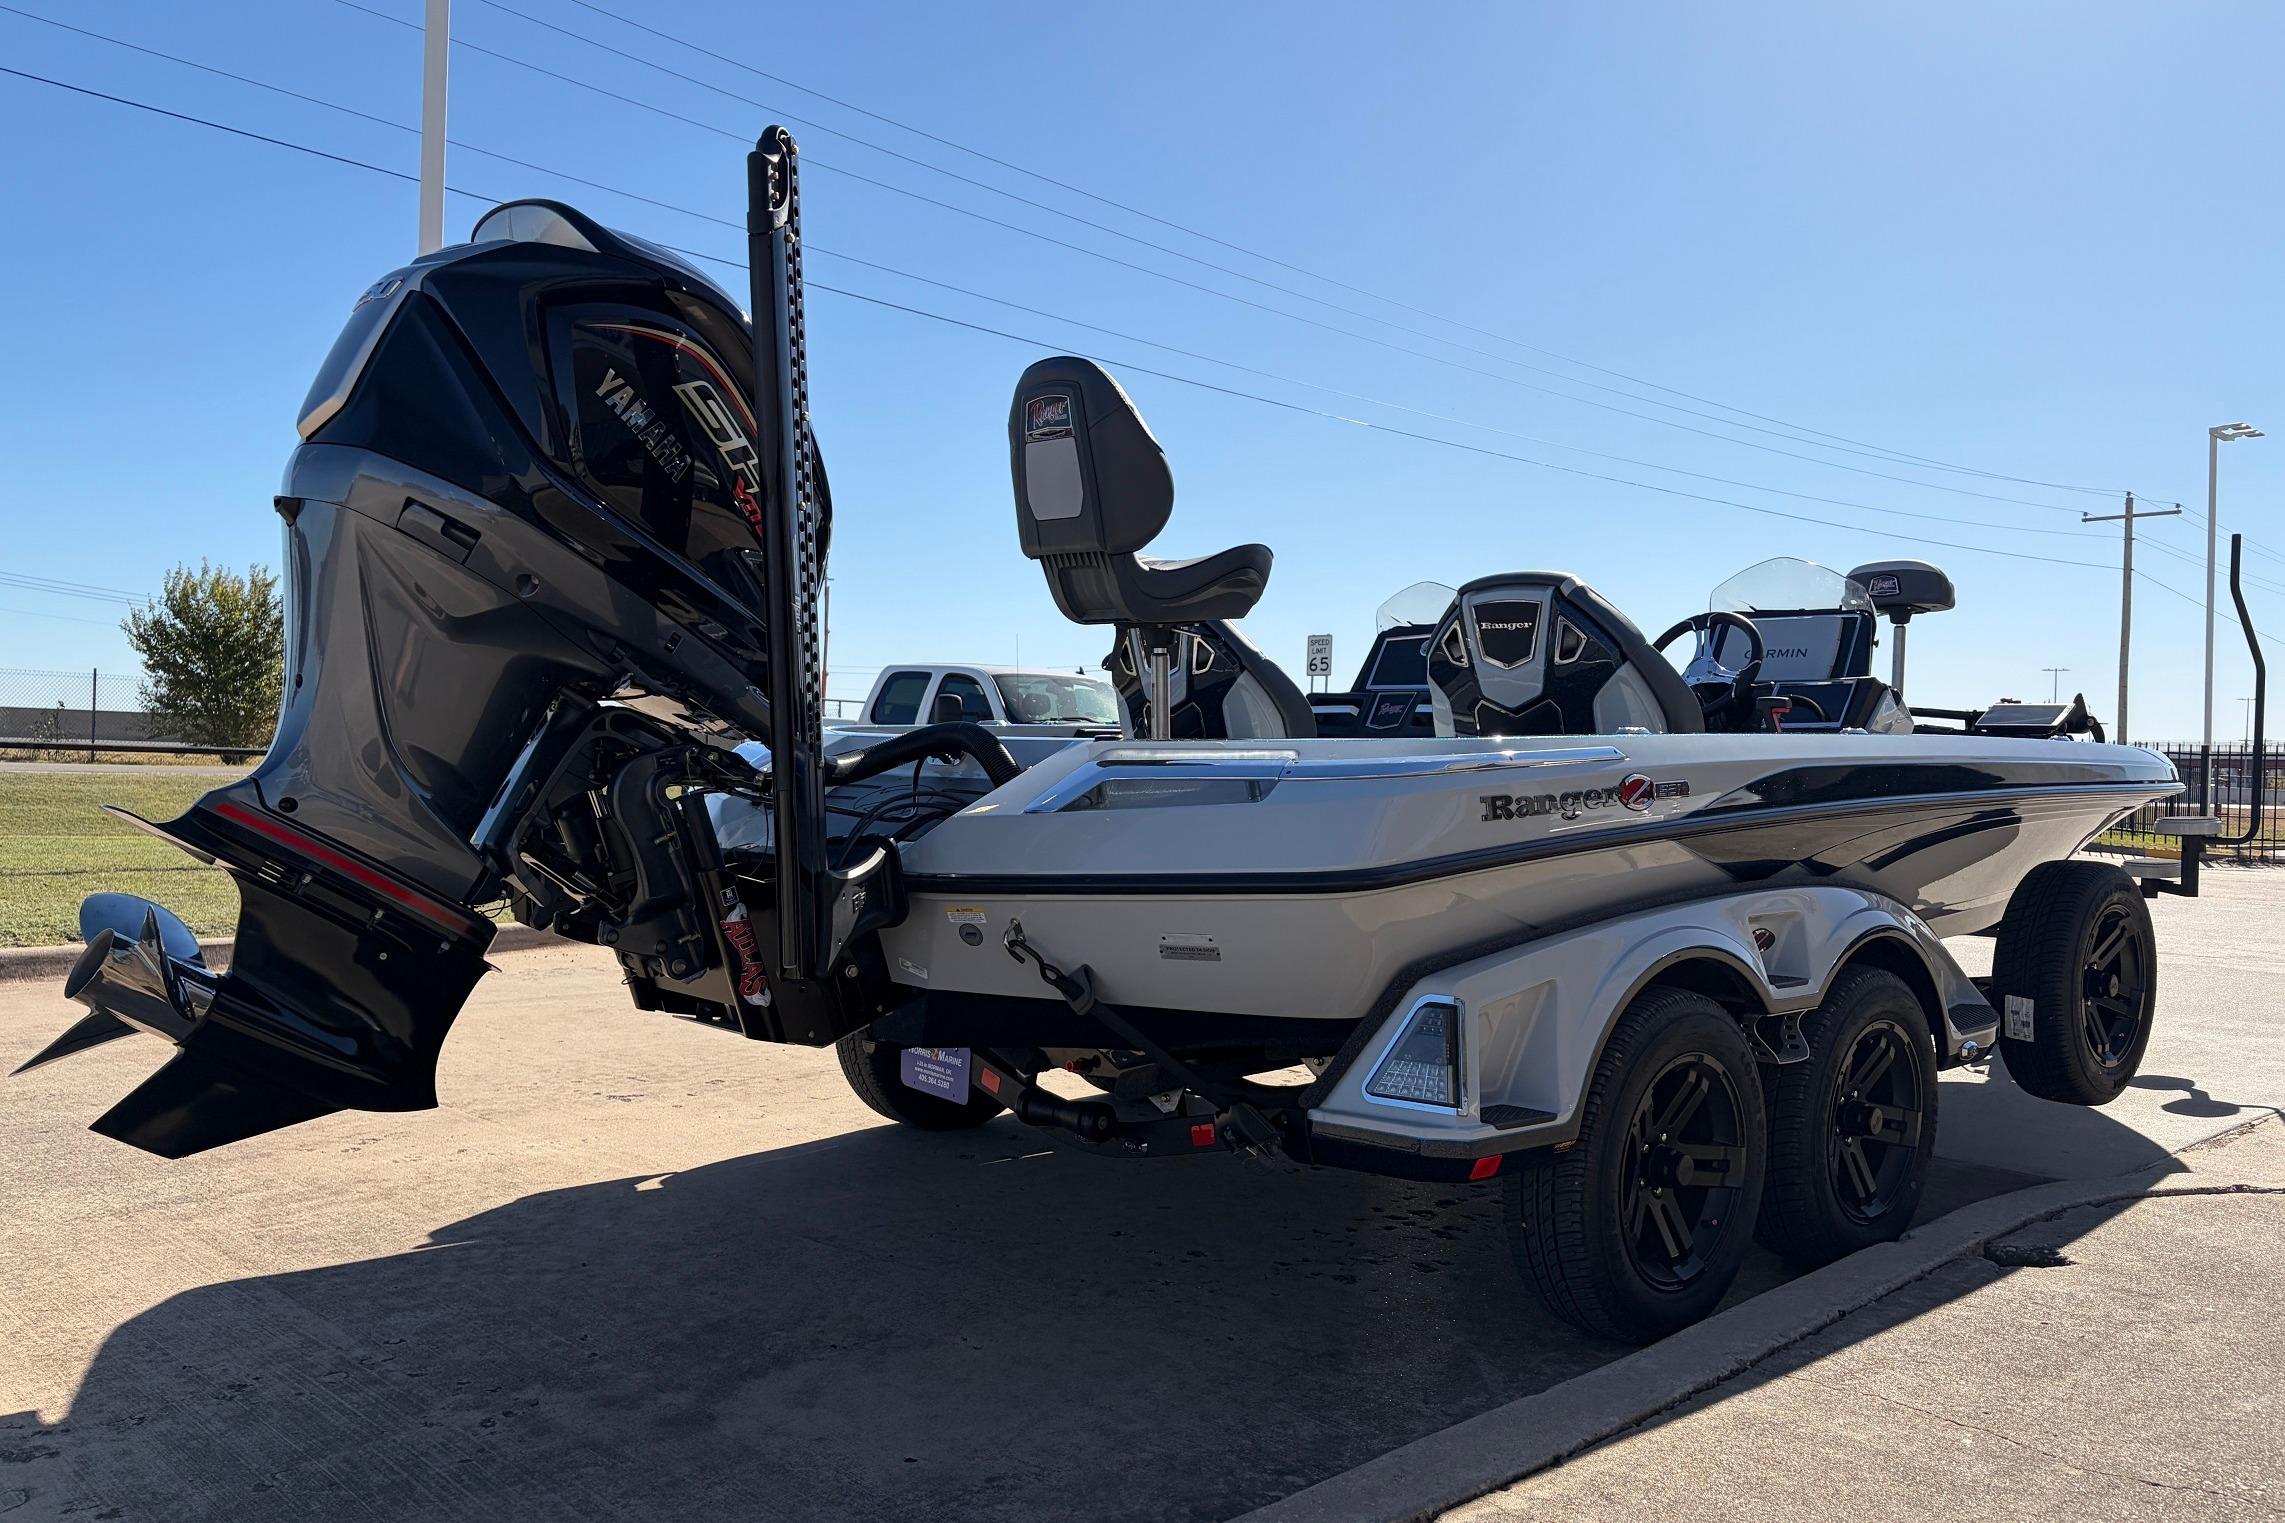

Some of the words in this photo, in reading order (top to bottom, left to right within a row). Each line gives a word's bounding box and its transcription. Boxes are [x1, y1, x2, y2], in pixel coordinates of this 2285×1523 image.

[595, 367, 694, 484] YAMAHA
[671, 379, 760, 495] SH
[1480, 622, 1532, 631] Ranger
[1310, 638, 1329, 646] SPEED
[1311, 647, 1327, 655] LIMIT
[1744, 647, 1808, 660] GRMIN
[1309, 657, 1329, 672] 65
[1480, 789, 1620, 821] Ranger
[938, 1050, 962, 1067] MARINE
